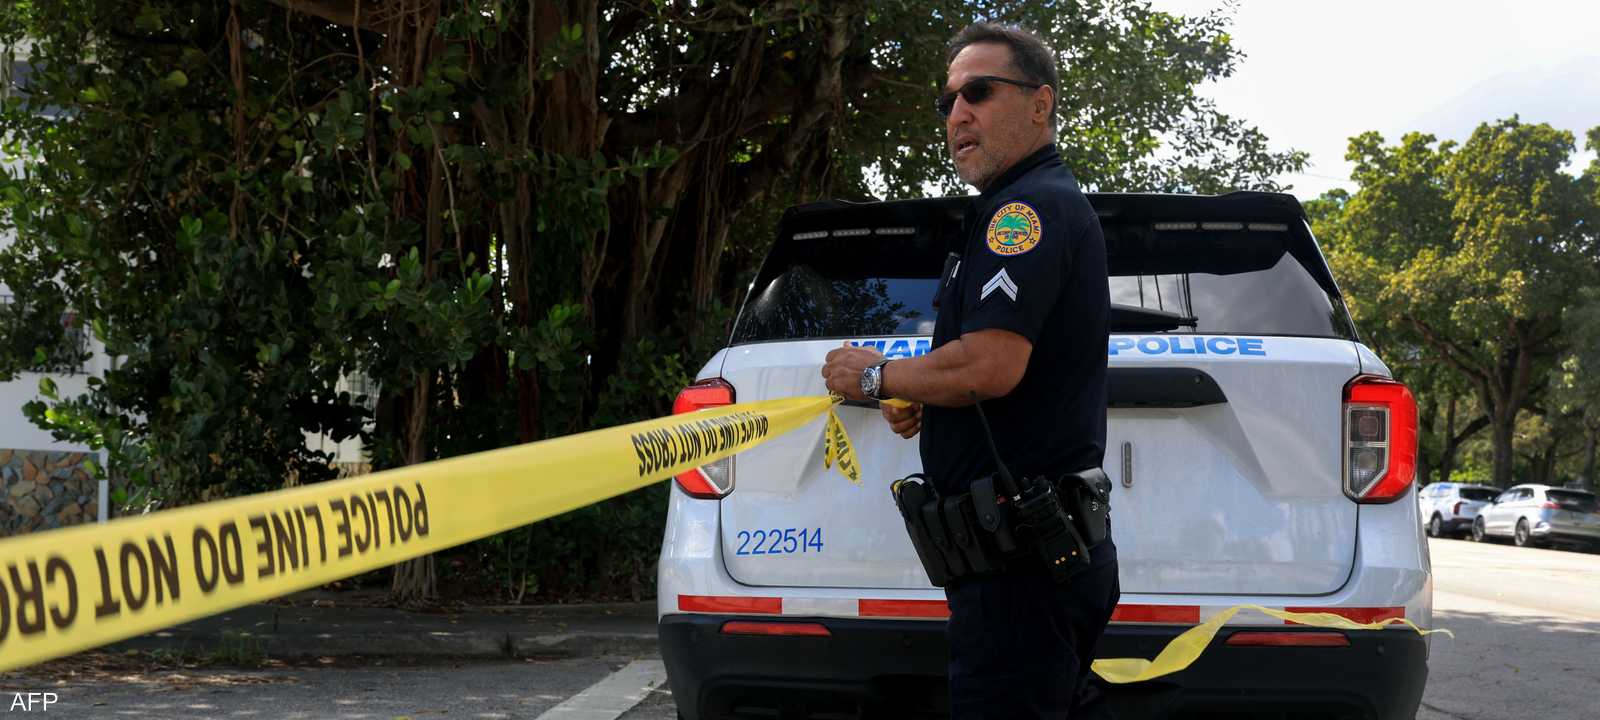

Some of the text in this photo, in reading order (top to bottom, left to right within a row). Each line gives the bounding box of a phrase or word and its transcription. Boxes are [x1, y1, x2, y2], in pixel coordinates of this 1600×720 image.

[998, 205, 1012, 217] CITY
[1026, 210, 1040, 234] MIAMI
[1108, 336, 1267, 356] POLICE
[631, 428, 678, 477] CROSS
[673, 423, 702, 463] NOT
[696, 420, 718, 456] DO
[249, 502, 327, 578] LINE
[328, 481, 430, 558] POLICE
[736, 527, 824, 556] 222514
[95, 533, 181, 619] NOT
[192, 520, 245, 593] DO
